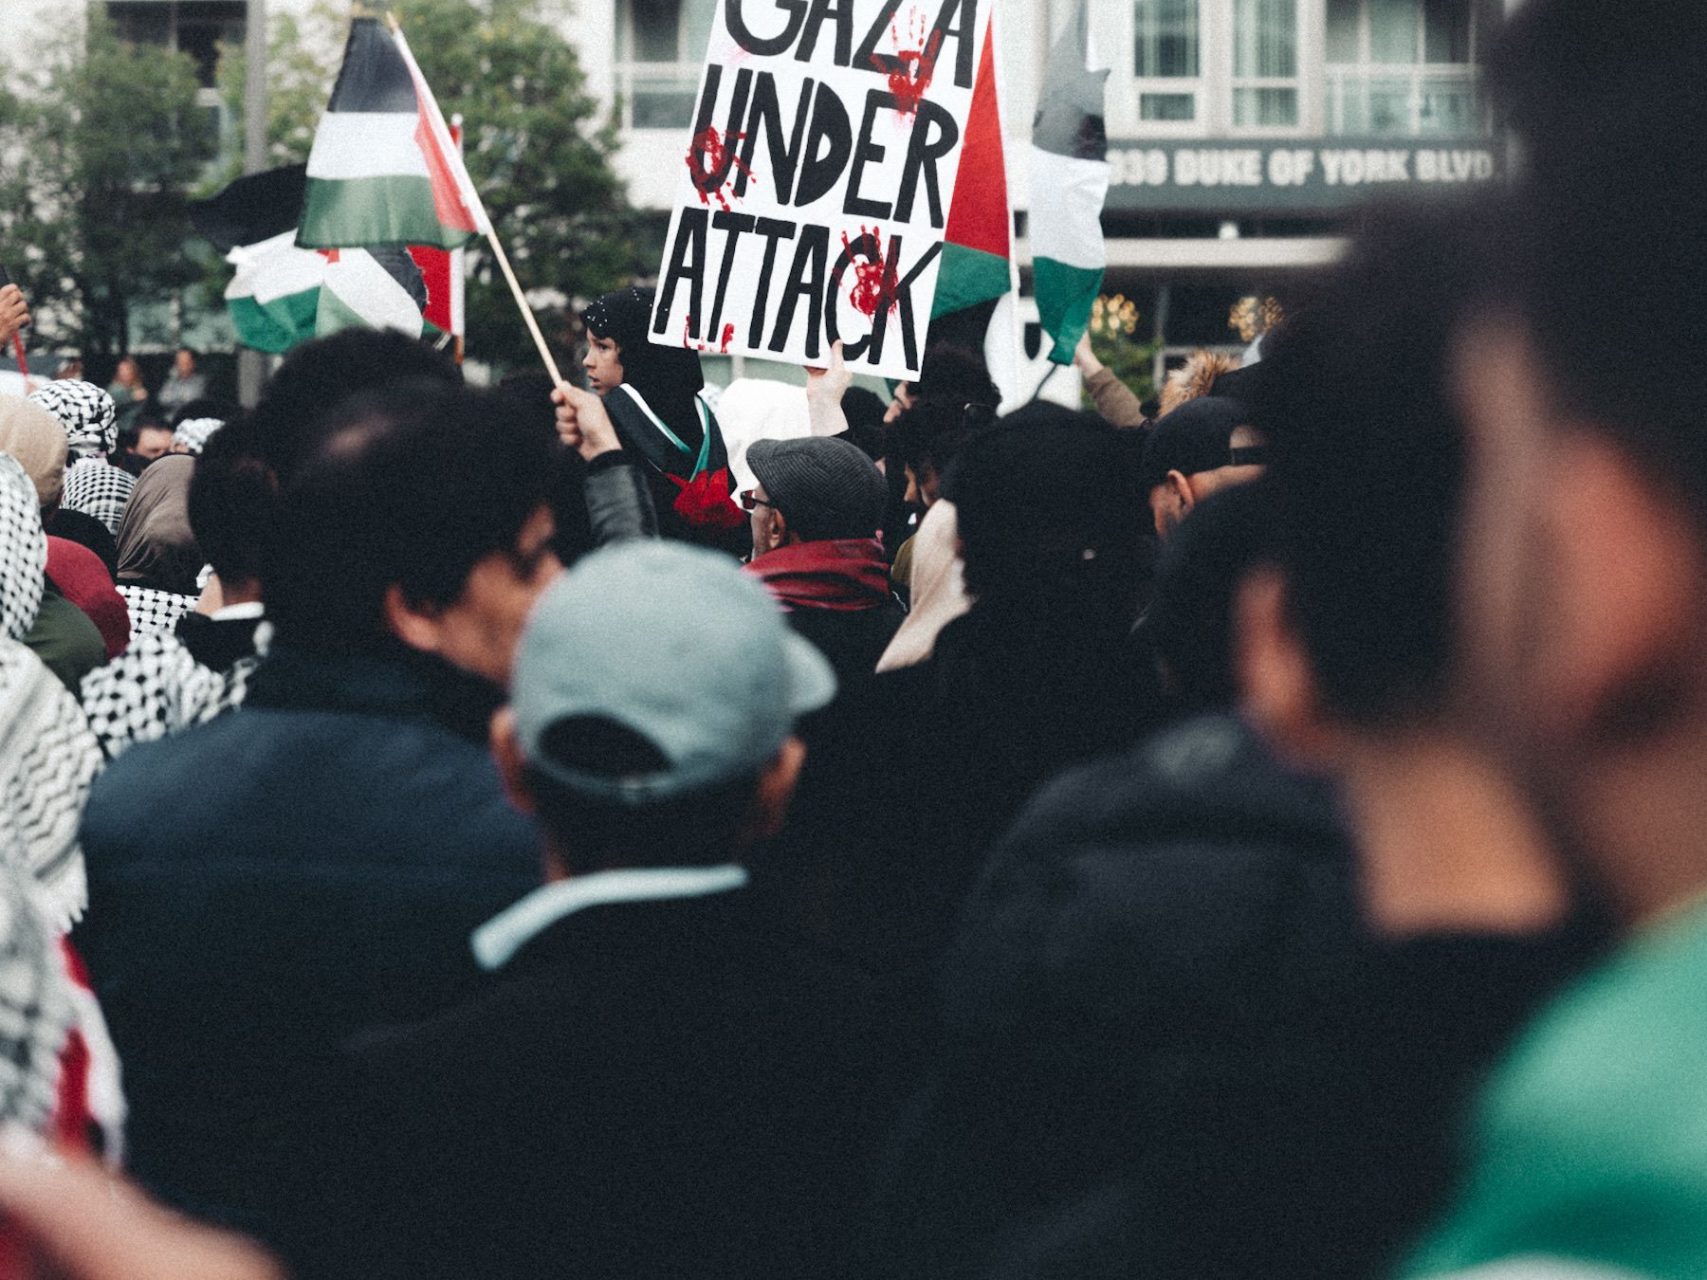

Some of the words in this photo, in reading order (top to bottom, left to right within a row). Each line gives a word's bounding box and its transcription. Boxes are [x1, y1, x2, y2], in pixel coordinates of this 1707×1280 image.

[688, 64, 959, 228] UNDER
[1173, 148, 1262, 186] DUKE
[1267, 148, 1314, 186] OF
[1319, 148, 1409, 185] YORK
[1414, 149, 1493, 182] BLVD
[652, 206, 944, 372] ATTACK
